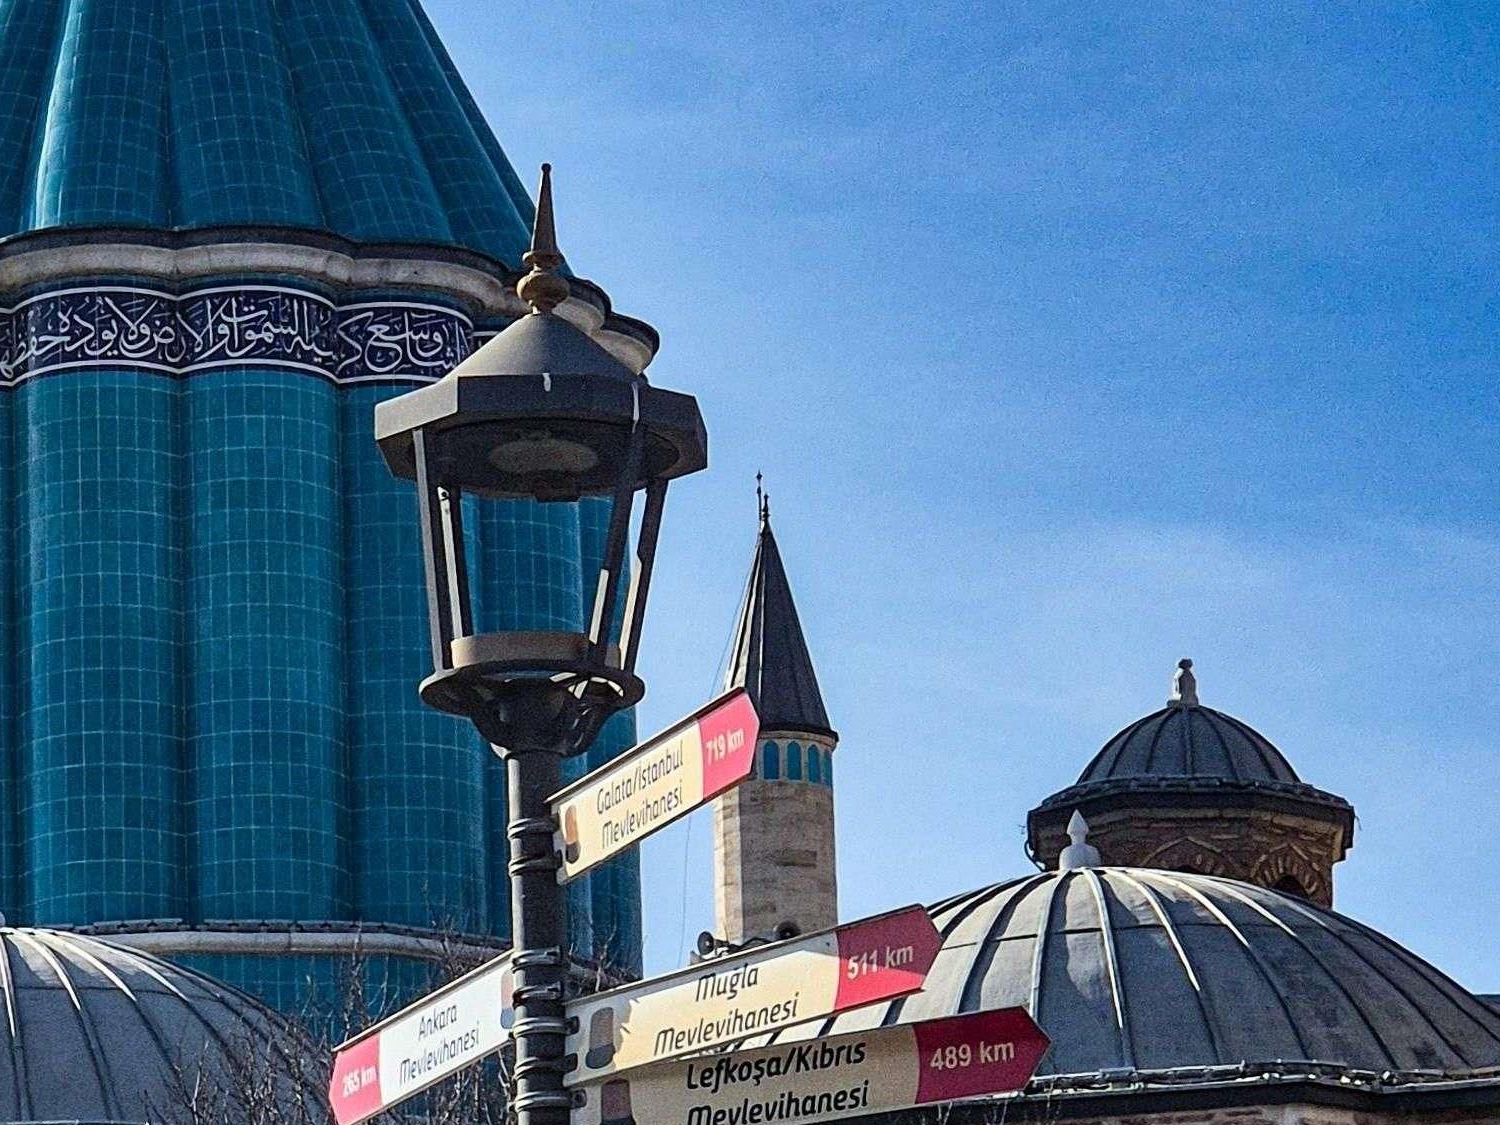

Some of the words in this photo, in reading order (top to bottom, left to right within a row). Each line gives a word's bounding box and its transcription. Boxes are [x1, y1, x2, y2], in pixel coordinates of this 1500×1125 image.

[705, 736, 726, 766] 719
[727, 727, 745, 753] km
[601, 779, 683, 849] Mevlevihanesi
[846, 953, 878, 979] 511
[886, 944, 914, 969] km
[695, 962, 759, 1002] Muğla
[417, 1003, 458, 1041] Ankara
[654, 992, 800, 1056] Mevlevihanesi
[399, 1020, 480, 1086] Mevlevihanesi
[687, 1040, 867, 1090] Lefkoşa/Kıbrıs
[930, 1043, 971, 1071] 489
[979, 1040, 1015, 1064] km
[360, 1064, 378, 1089] km
